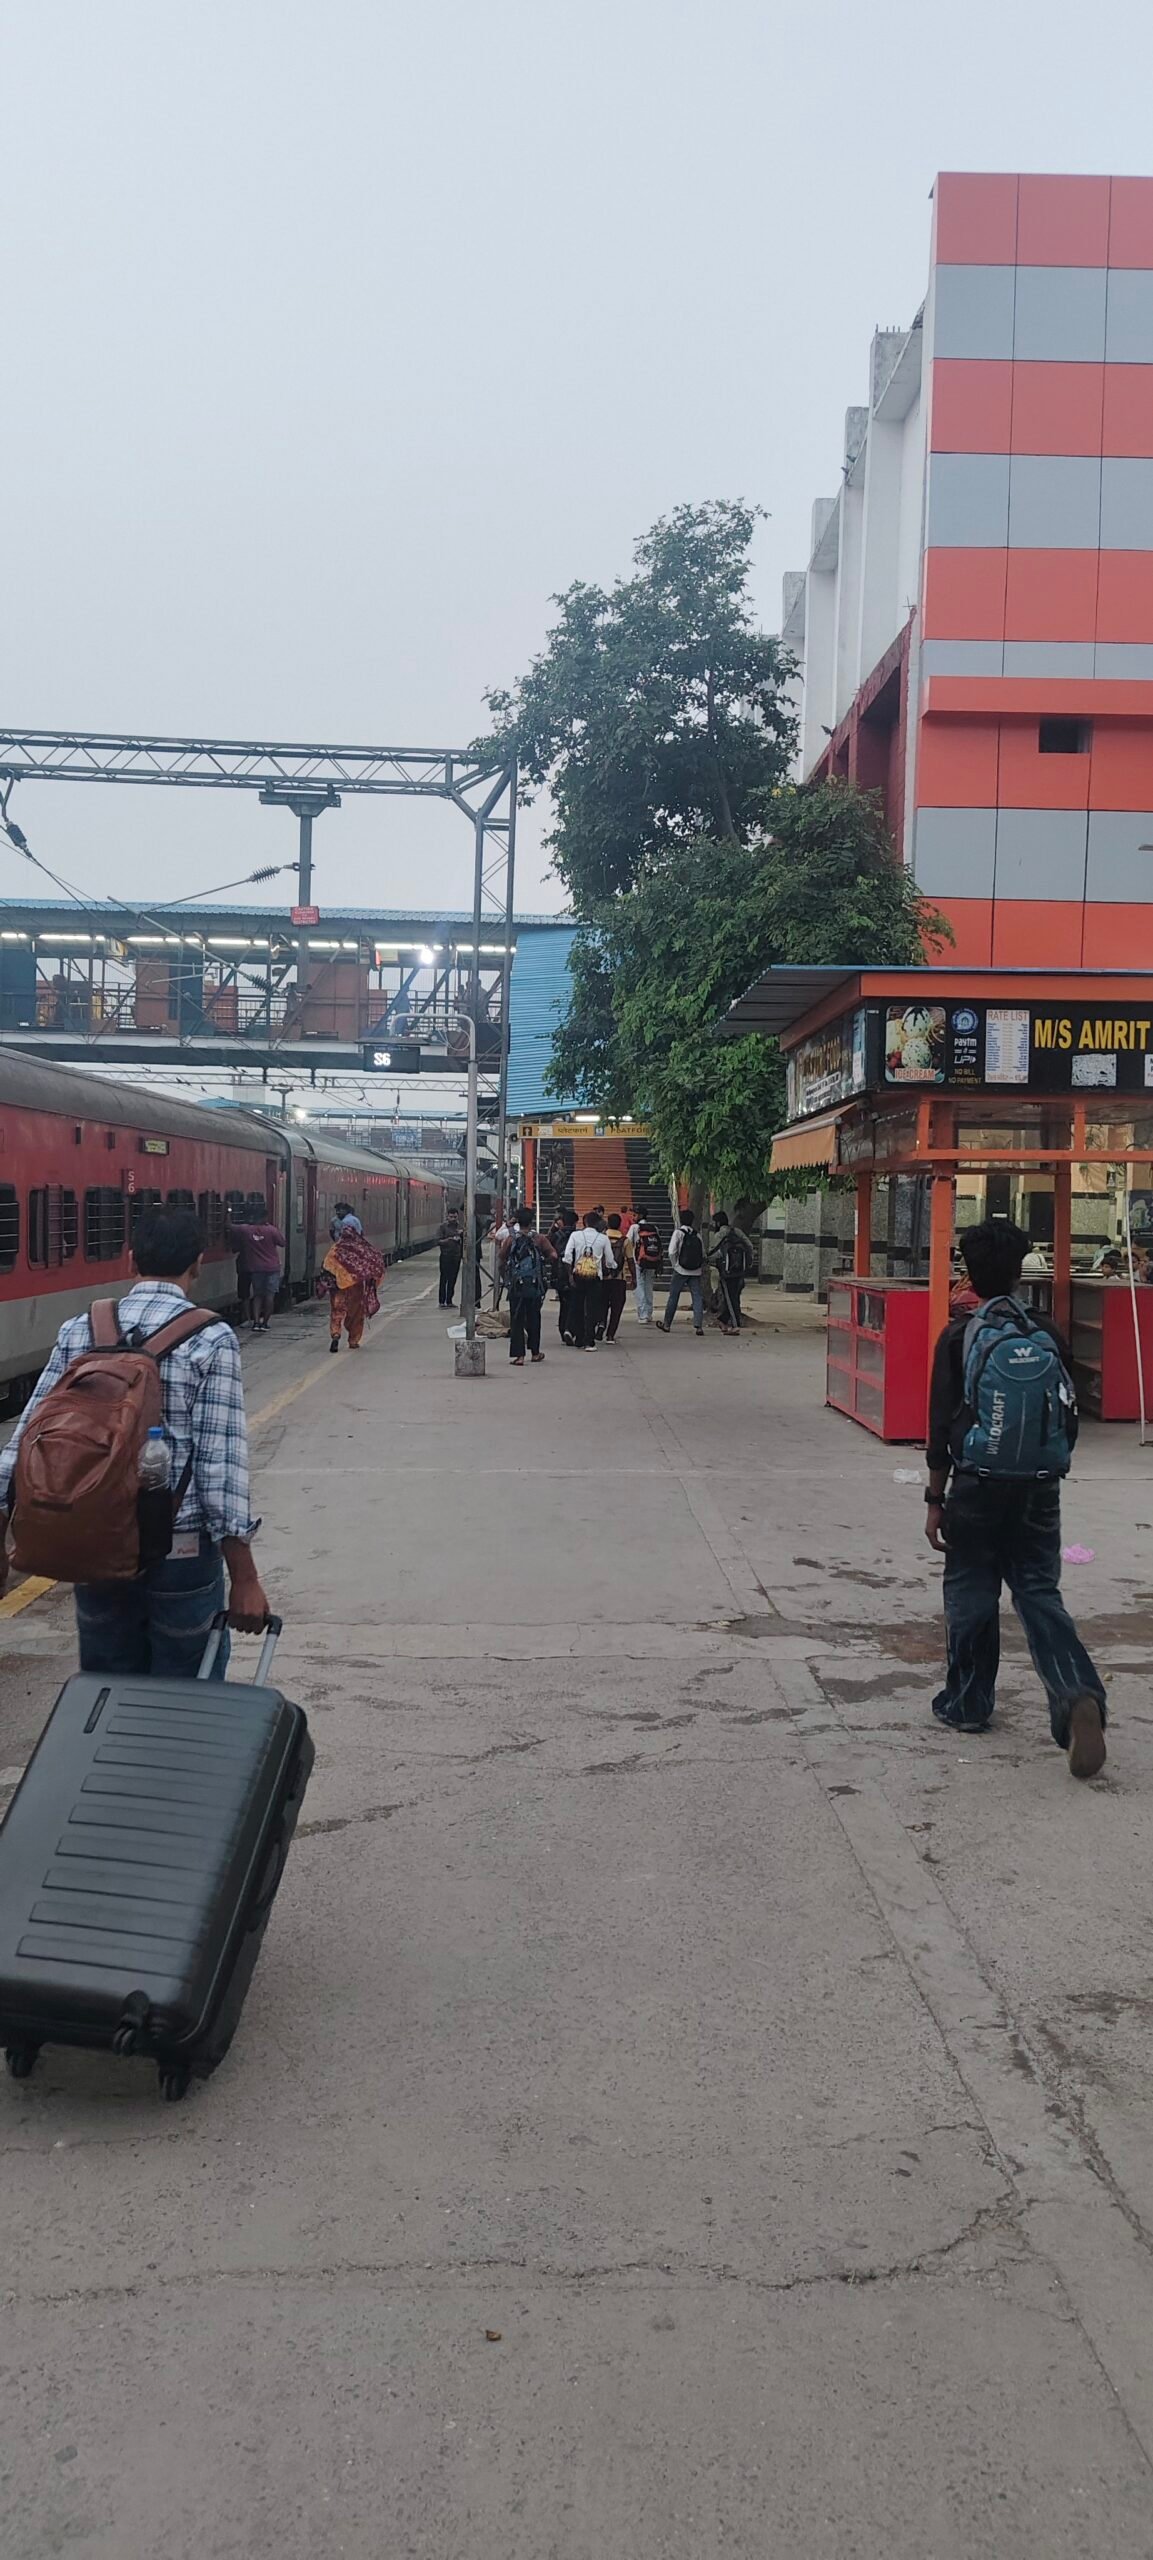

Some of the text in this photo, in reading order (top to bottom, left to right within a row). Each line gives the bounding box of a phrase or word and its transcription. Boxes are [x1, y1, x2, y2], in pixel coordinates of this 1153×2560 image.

[987, 1010, 1008, 1021] RATE
[1010, 1010, 1028, 1021] LIST
[1034, 1018, 1072, 1049] M/S
[1078, 1020, 1151, 1050] AMRIT
[373, 1052, 391, 1066] S6
[985, 1390, 1007, 1455] WILDCRAFT
